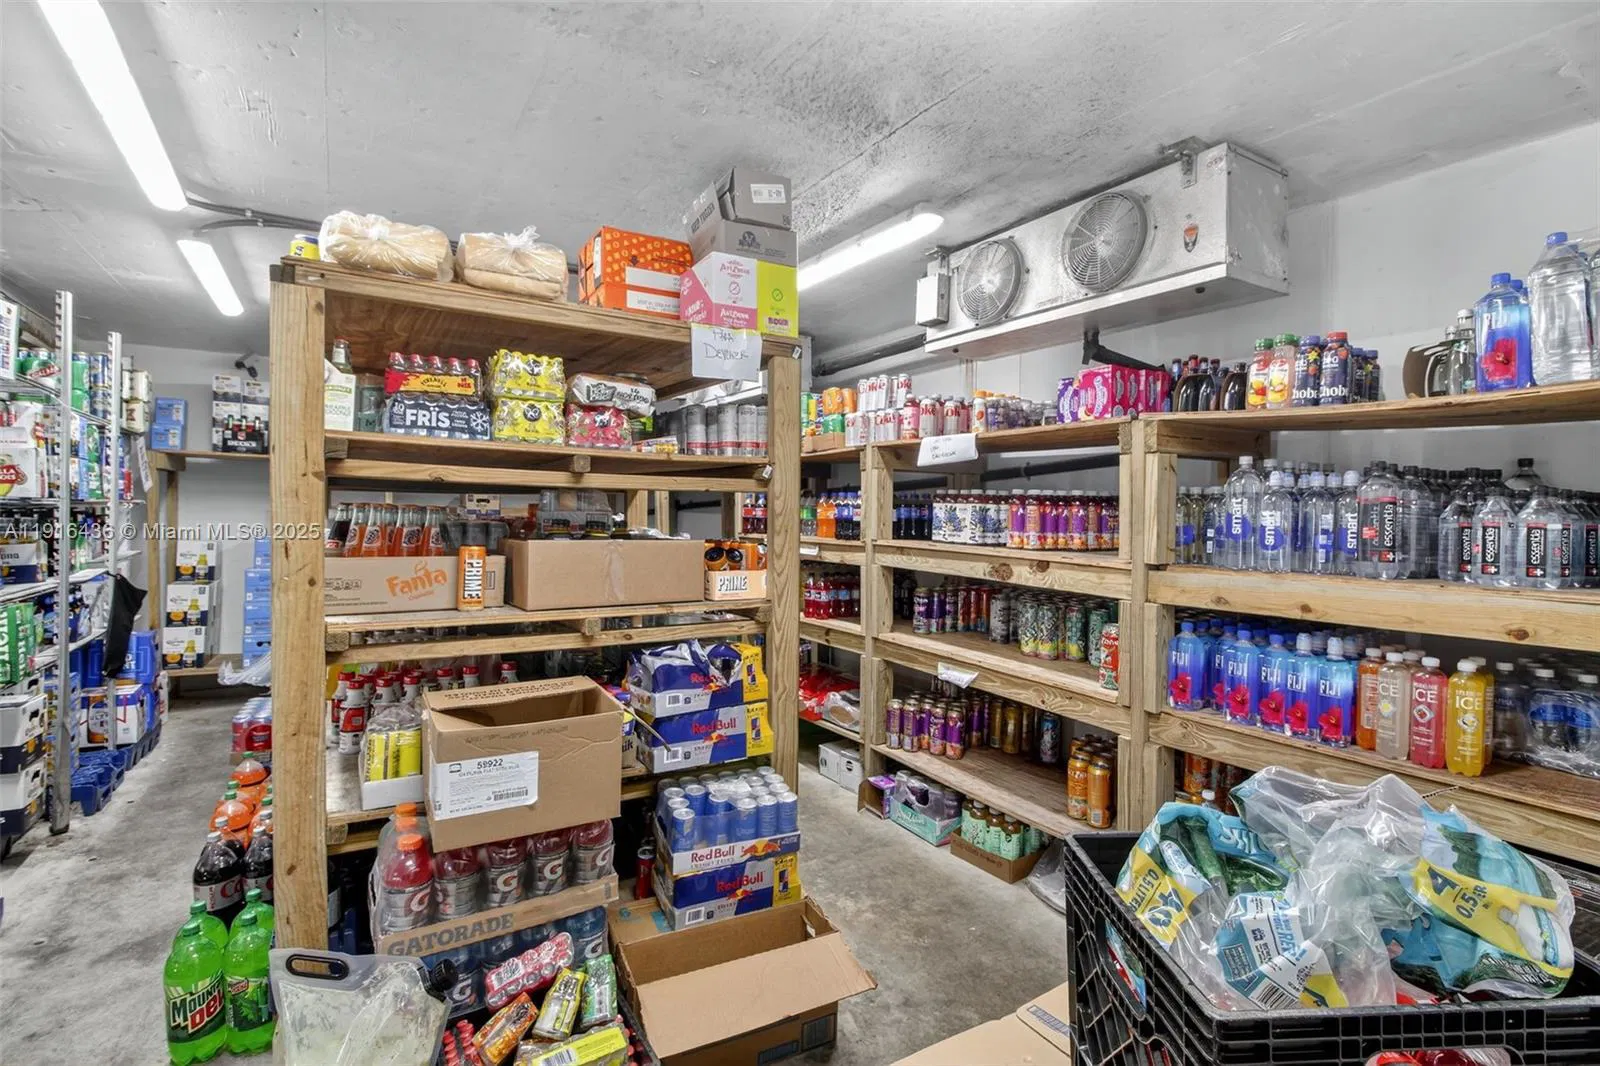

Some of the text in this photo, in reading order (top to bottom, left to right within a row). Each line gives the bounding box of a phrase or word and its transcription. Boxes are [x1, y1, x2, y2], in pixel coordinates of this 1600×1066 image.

[1383, 503, 1394, 547] essentia
[385, 566, 447, 597] Fanta
[464, 558, 484, 600] PRIME
[718, 575, 748, 592] PRIME
[1228, 659, 1248, 677] FIJI
[1287, 673, 1307, 692] FIJI
[1320, 679, 1341, 697] FIJI
[691, 845, 736, 863] Red Bull
[387, 913, 514, 956] GATORADE
